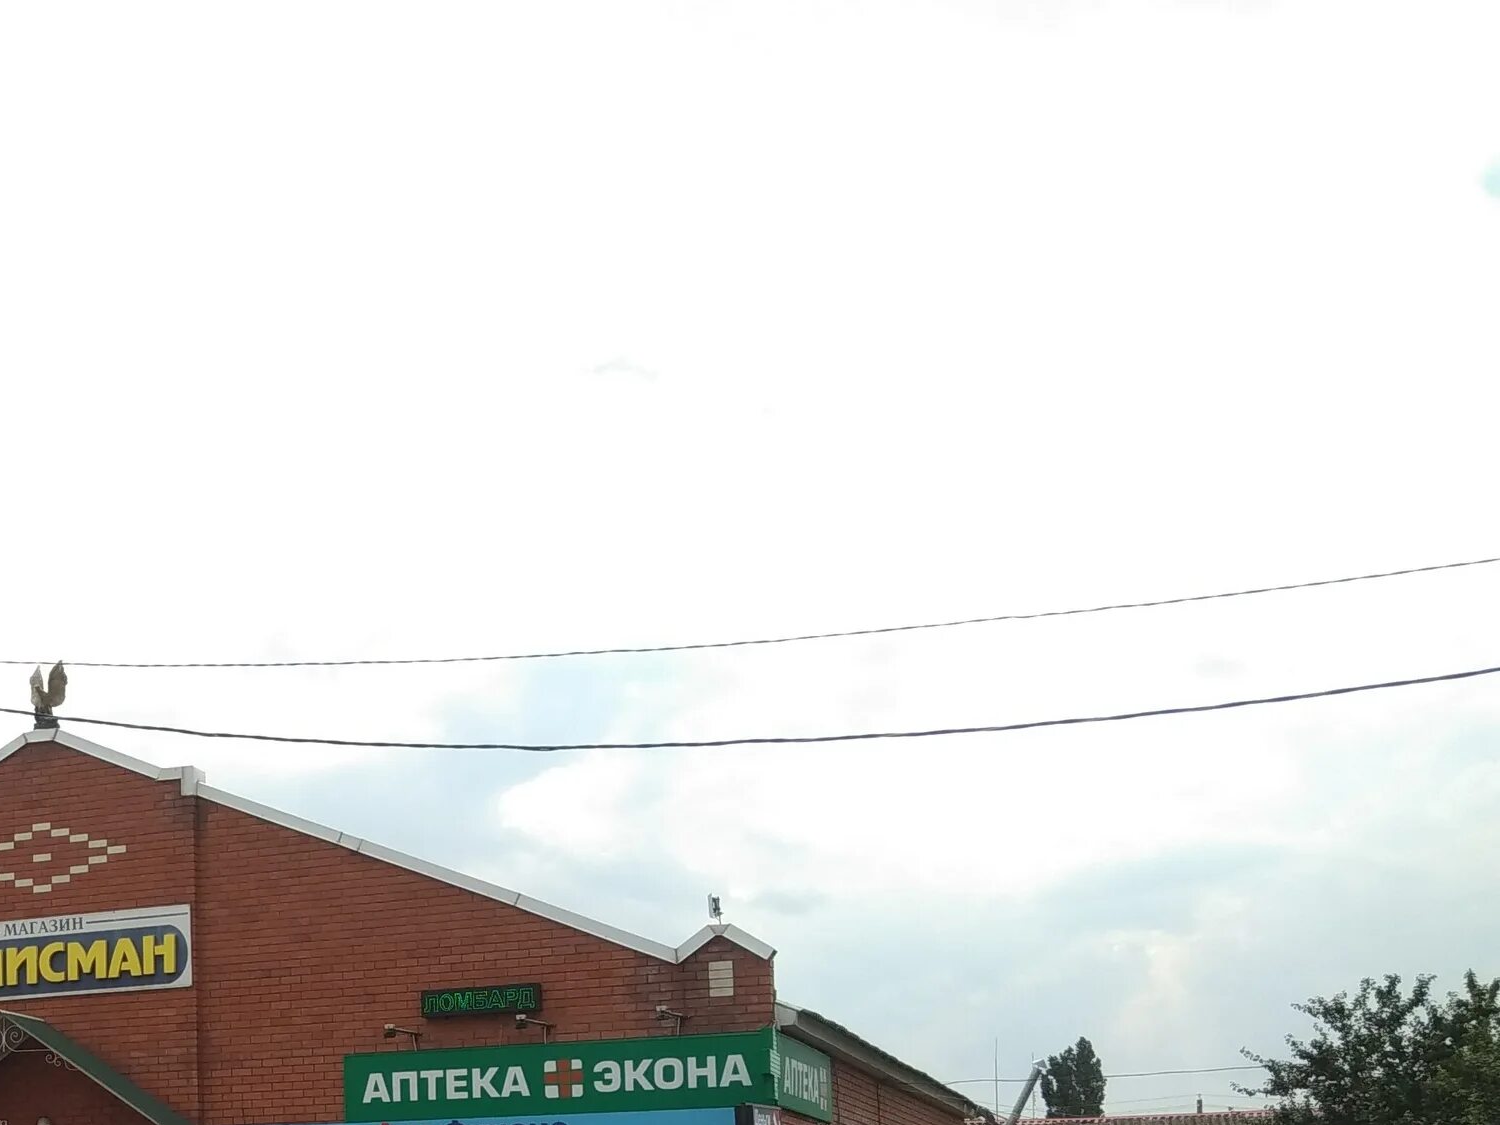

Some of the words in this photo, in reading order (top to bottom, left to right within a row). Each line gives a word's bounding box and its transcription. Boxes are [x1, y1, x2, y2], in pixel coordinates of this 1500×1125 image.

[3, 917, 84, 937] МАГАЗИН
[423, 987, 536, 1013] ЛОМБАРД
[362, 1066, 531, 1104] АПТЕКА
[593, 1053, 752, 1093] ЭКОНА
[783, 1056, 819, 1104] АПТЕКА
